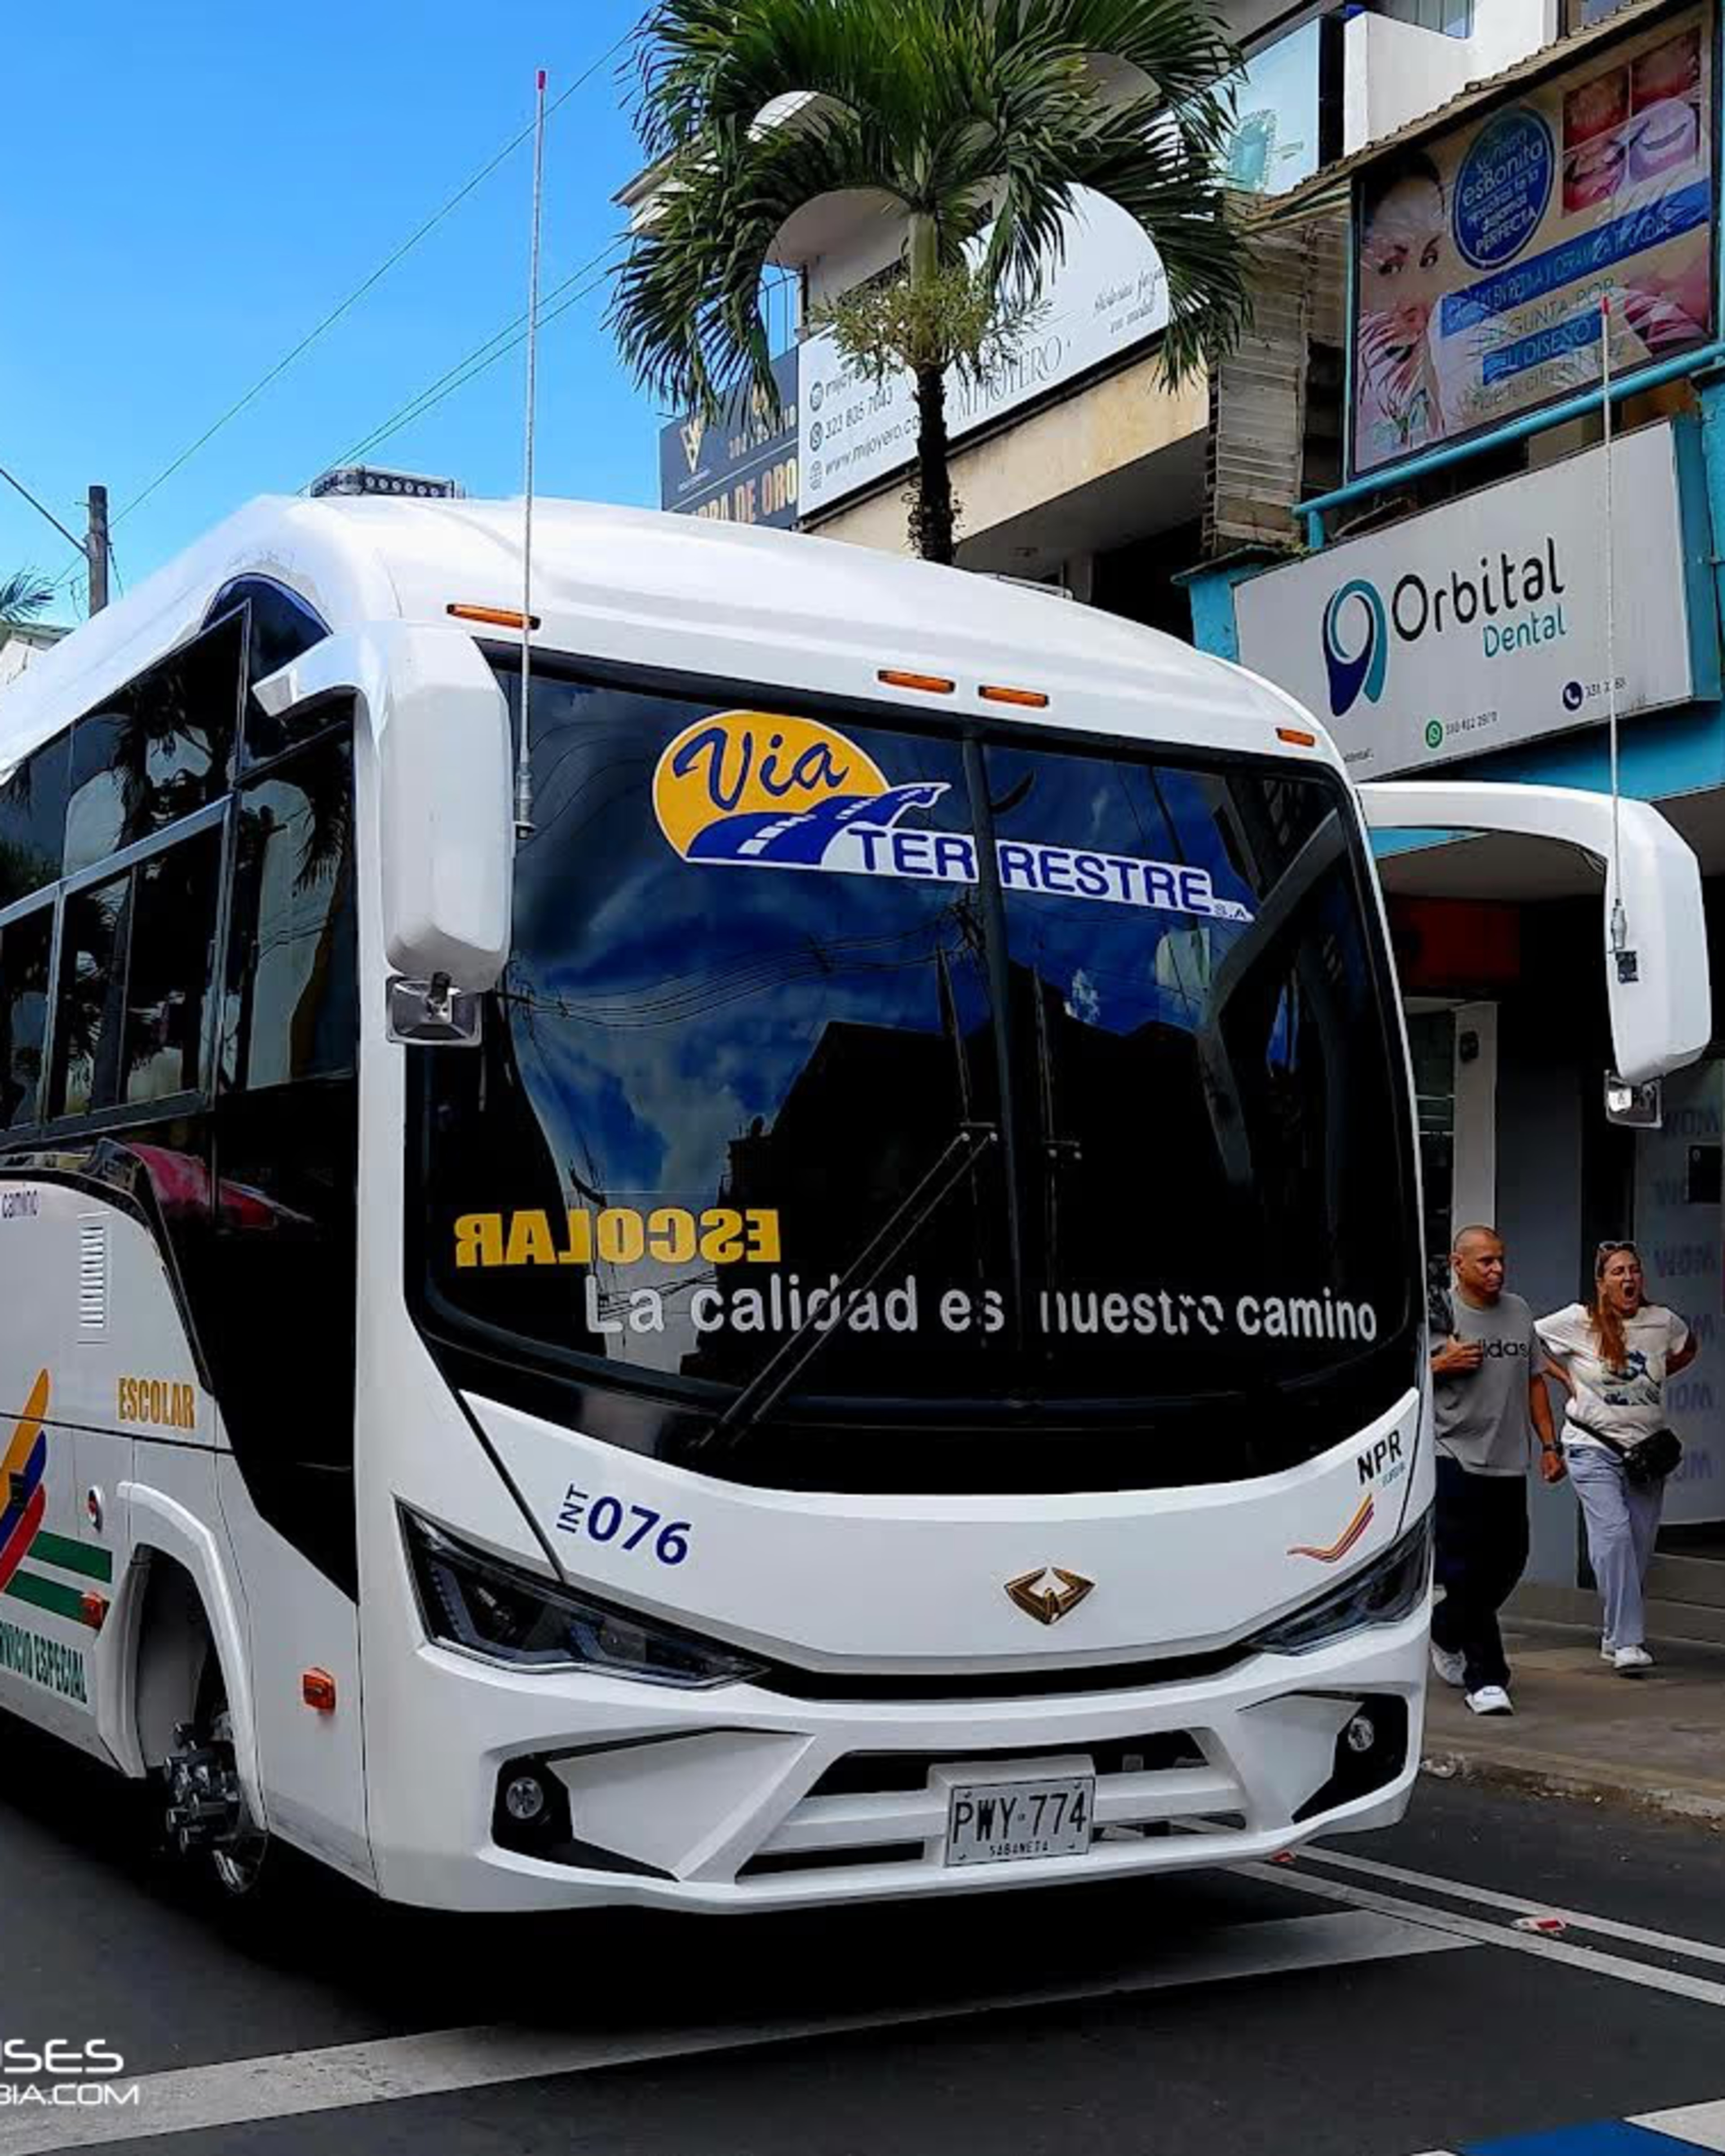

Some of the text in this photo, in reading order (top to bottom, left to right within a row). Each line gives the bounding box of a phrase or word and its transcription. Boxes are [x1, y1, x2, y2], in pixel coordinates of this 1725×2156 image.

[762, 457, 796, 517] ORO
[1393, 537, 1565, 641] Orbital
[1483, 604, 1566, 658] Dental
[672, 727, 849, 810] Via
[849, 828, 1211, 914] TERRESTRE
[585, 1272, 1376, 1341] La calidad es nuestro camino
[119, 1378, 194, 1428] ESCOLAR
[1357, 1429, 1402, 1485] NPR
[556, 1484, 692, 1565] INT 076
[34, 1634, 87, 1705] ESPECIAL
